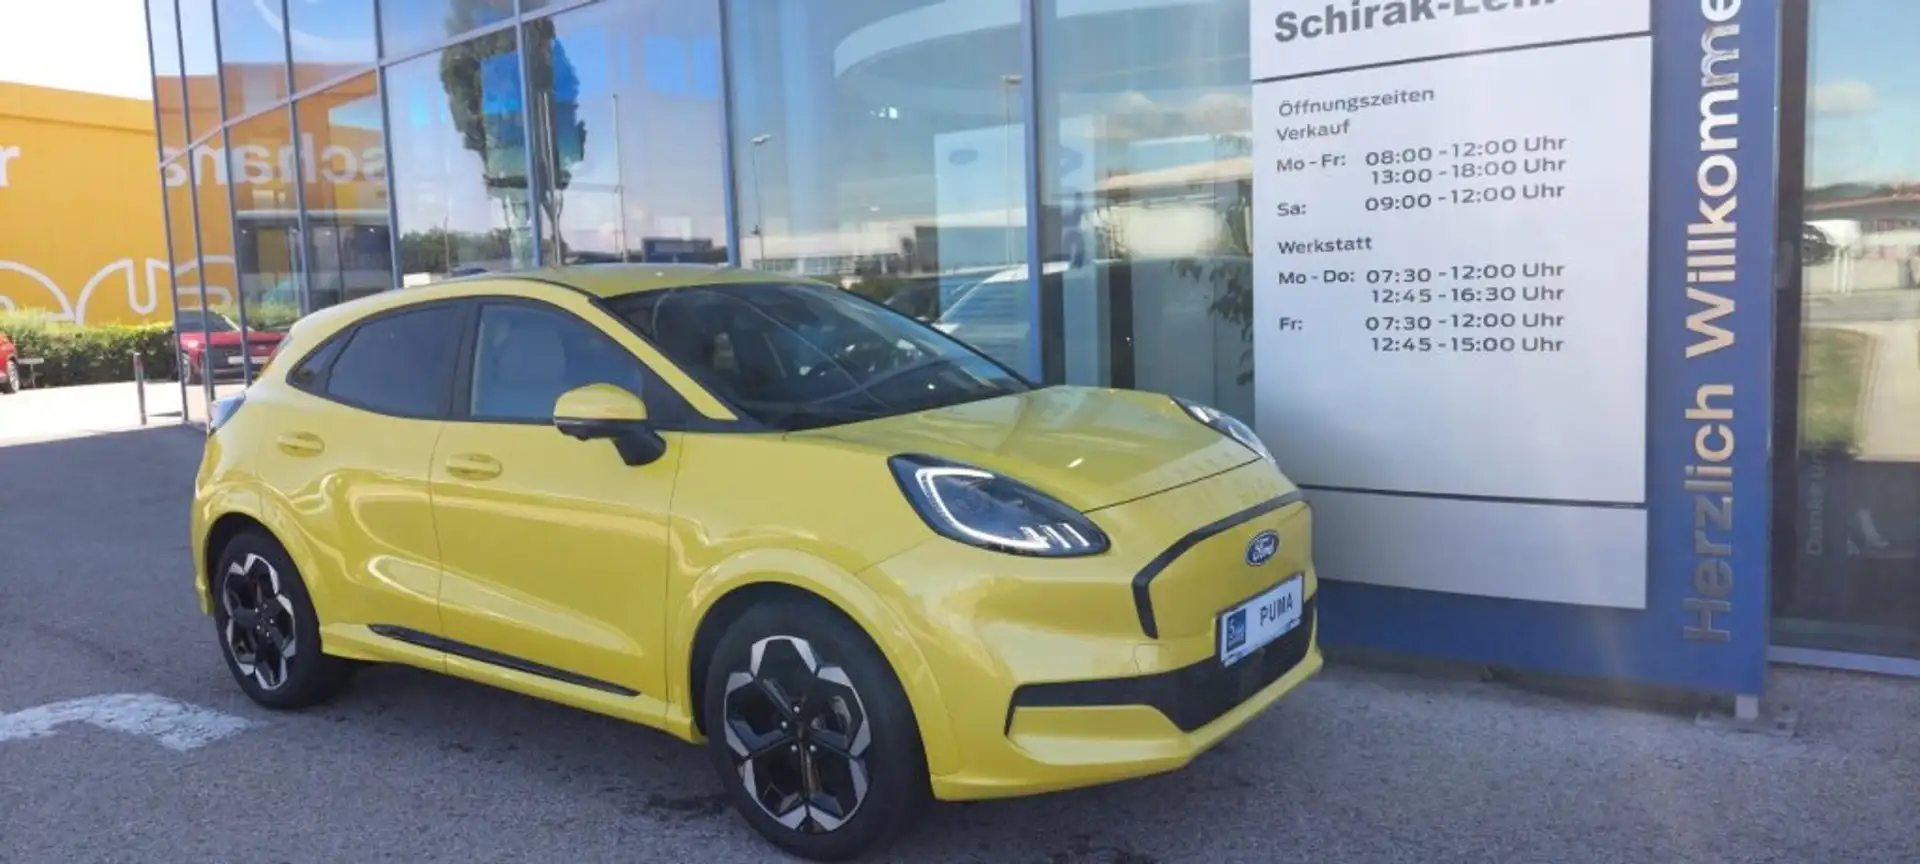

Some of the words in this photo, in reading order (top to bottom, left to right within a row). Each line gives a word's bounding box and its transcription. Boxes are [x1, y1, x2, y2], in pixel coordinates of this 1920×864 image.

[1274, 0, 1555, 42] Schirak-L
[1279, 88, 1434, 117] Öffnungszeiten
[1276, 119, 1350, 142] Verkauf
[1277, 158, 1305, 172] Mo
[1321, 154, 1346, 168] Fr:
[1365, 147, 1432, 166] 08:00
[1452, 139, 1517, 158] 12:00
[1524, 136, 1566, 152] Uhr
[1372, 168, 1432, 185] 13:00
[1452, 161, 1517, 178] 18:00
[1524, 157, 1566, 174] Uhr
[1277, 202, 1306, 216] Sa:
[1365, 193, 1432, 211] 09:00
[1451, 186, 1516, 204] 12:00
[1523, 183, 1565, 199] Uhr
[1277, 237, 1372, 254] Werkstatt
[1279, 272, 1307, 285] Mo
[1323, 270, 1355, 284] Do:
[1366, 268, 1432, 284] 07:30
[1450, 264, 1516, 280] 12:00
[1522, 262, 1565, 278] Uhr
[1372, 289, 1432, 303] 12:45
[1451, 287, 1516, 302] 16:30
[1523, 285, 1564, 301] Uhr
[1279, 317, 1303, 331] Fr:
[1365, 316, 1432, 331] 07:30
[1451, 313, 1516, 328] 12:00
[1523, 312, 1564, 327] Uhr
[1372, 337, 1432, 352] 12:45
[1451, 337, 1515, 352] 15:00
[1522, 337, 1564, 352] Uhr
[1682, 384, 1734, 642] Herzlich
[1260, 592, 1293, 627] PUMA
